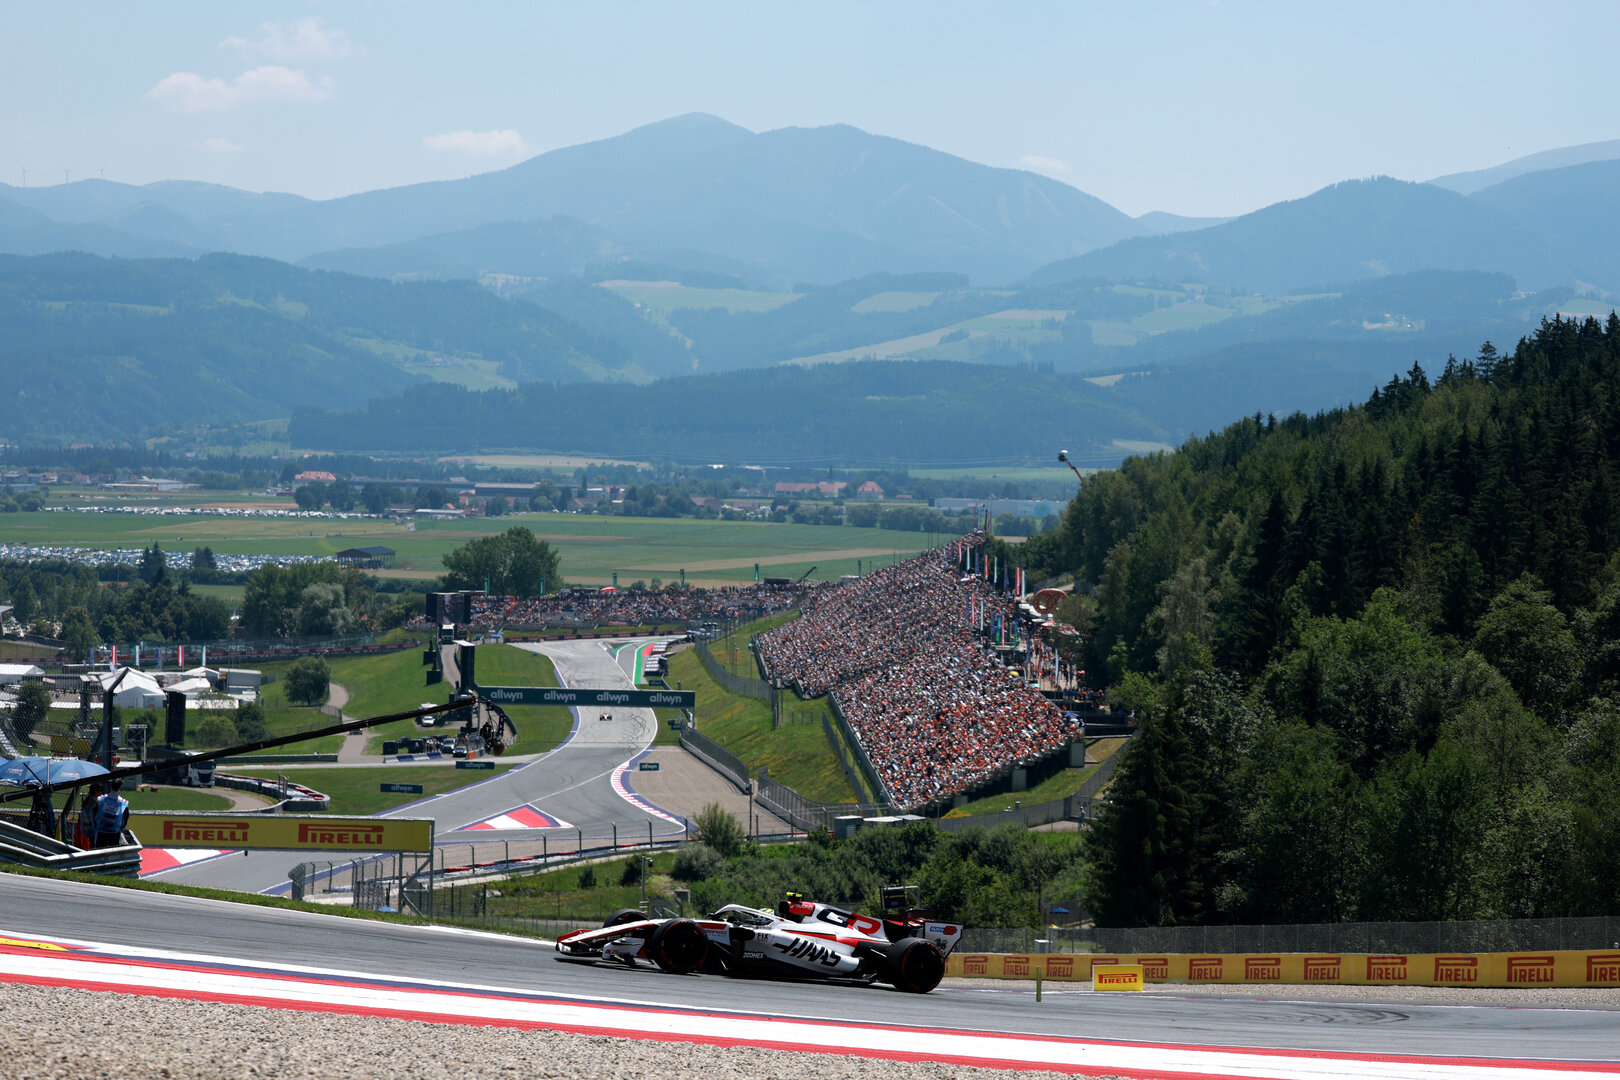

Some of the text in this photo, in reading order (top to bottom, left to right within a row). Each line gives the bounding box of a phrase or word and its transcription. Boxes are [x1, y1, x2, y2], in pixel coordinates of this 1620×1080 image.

[490, 689, 523, 702] allwyn
[543, 690, 576, 703] allwyn
[596, 692, 629, 704] allwyn
[650, 693, 682, 705] allwyn
[163, 820, 250, 842] PIRELLI
[298, 823, 385, 844] PIRELLI
[757, 932, 769, 940] FIX
[772, 937, 842, 967] HAAS
[963, 956, 988, 975] PIRELLI
[1003, 956, 1030, 976] PIRELLI
[1046, 957, 1074, 977] PIRELLI
[1188, 958, 1223, 980] PIRELLI
[1244, 957, 1281, 980] PIRELLI
[1304, 957, 1341, 980] PIRELLI
[1366, 956, 1408, 980] PIRELLI
[1433, 957, 1478, 982] PIRELLI
[1507, 956, 1555, 982] PIRELLI
[1098, 973, 1138, 984] PIRELLI
